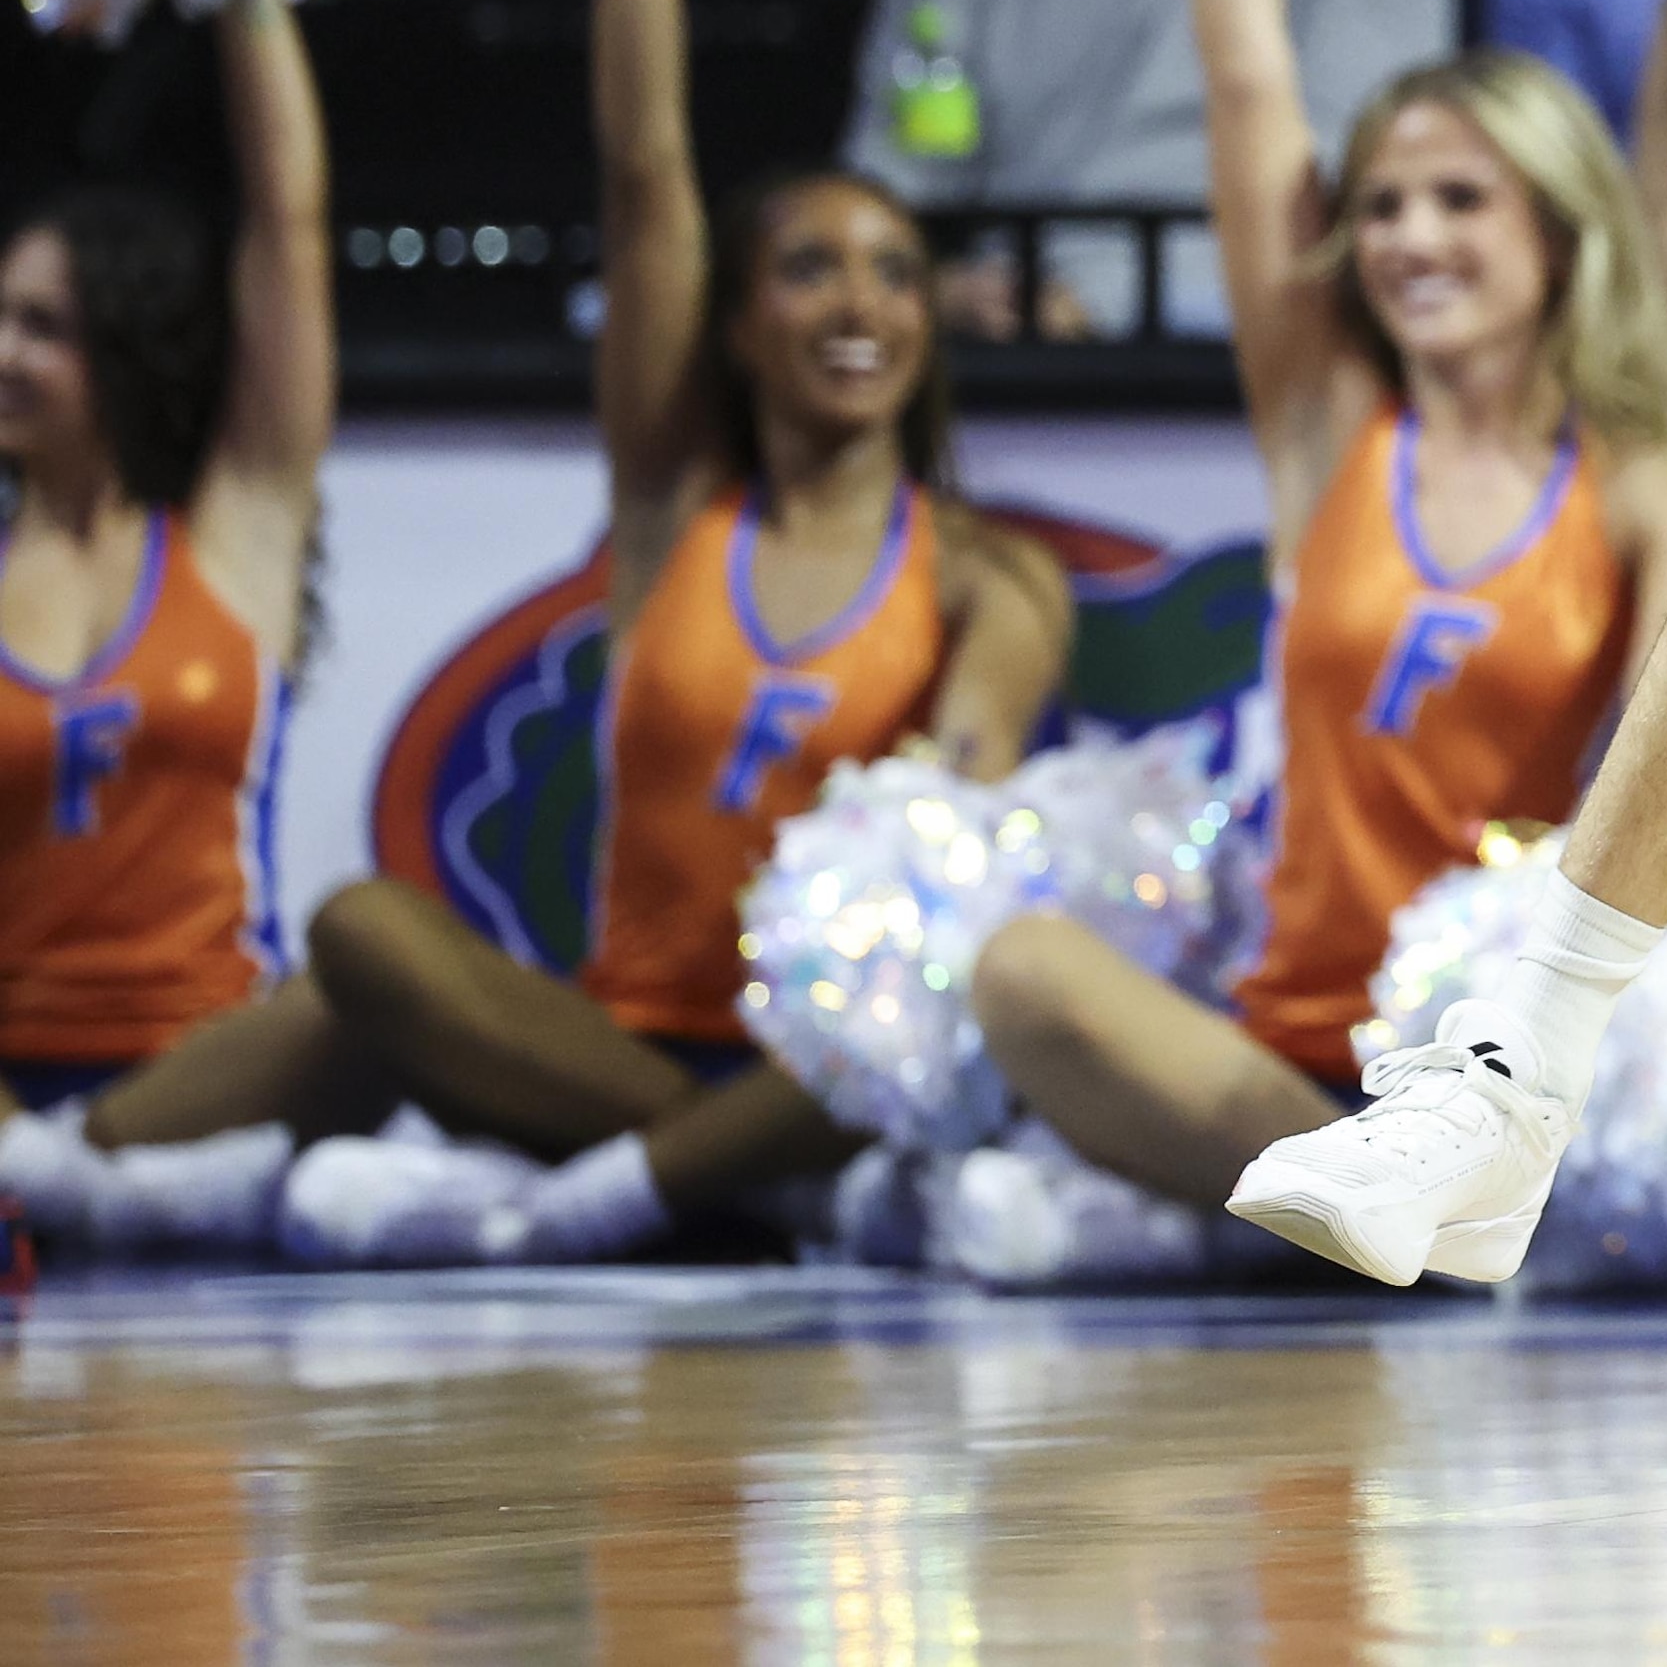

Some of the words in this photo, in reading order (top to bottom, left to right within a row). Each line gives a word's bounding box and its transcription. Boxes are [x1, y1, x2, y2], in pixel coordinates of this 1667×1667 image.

[1360, 594, 1500, 736] F
[53, 696, 138, 837] F
[714, 676, 838, 813] F
